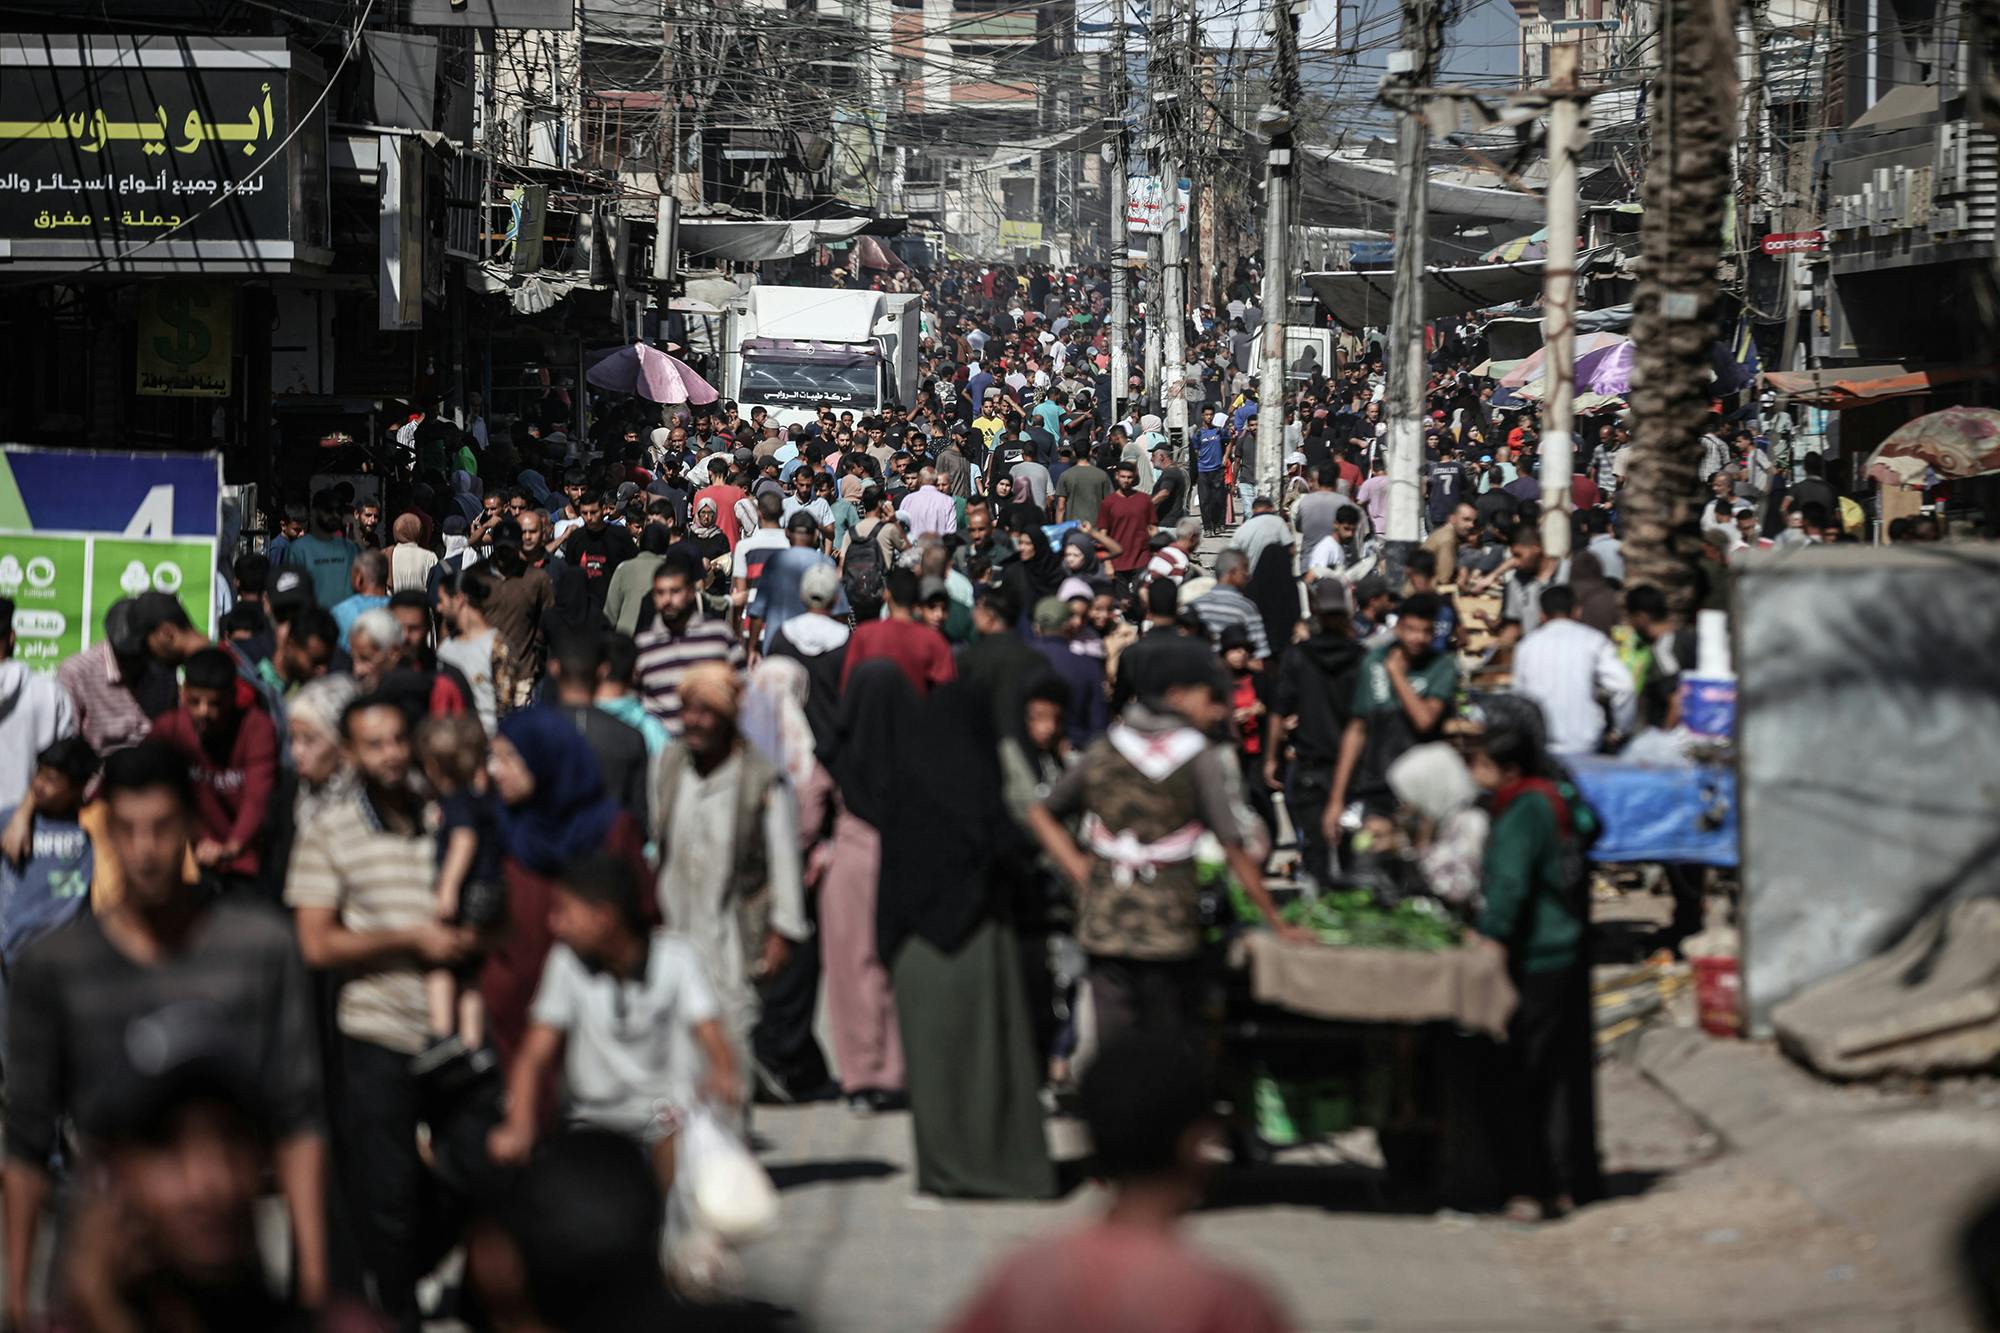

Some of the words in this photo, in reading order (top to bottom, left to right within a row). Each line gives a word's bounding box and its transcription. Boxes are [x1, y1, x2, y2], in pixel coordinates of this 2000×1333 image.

[175, 83, 274, 155] أبو
[35, 173, 113, 194] السجائر
[119, 169, 167, 195] أنواع
[172, 179, 217, 196] جميع
[223, 175, 264, 196] لبيع
[34, 210, 91, 228] مفرق
[121, 210, 181, 230] جملة
[824, 392, 852, 402] شركة
[1440, 474, 1453, 496] 7
